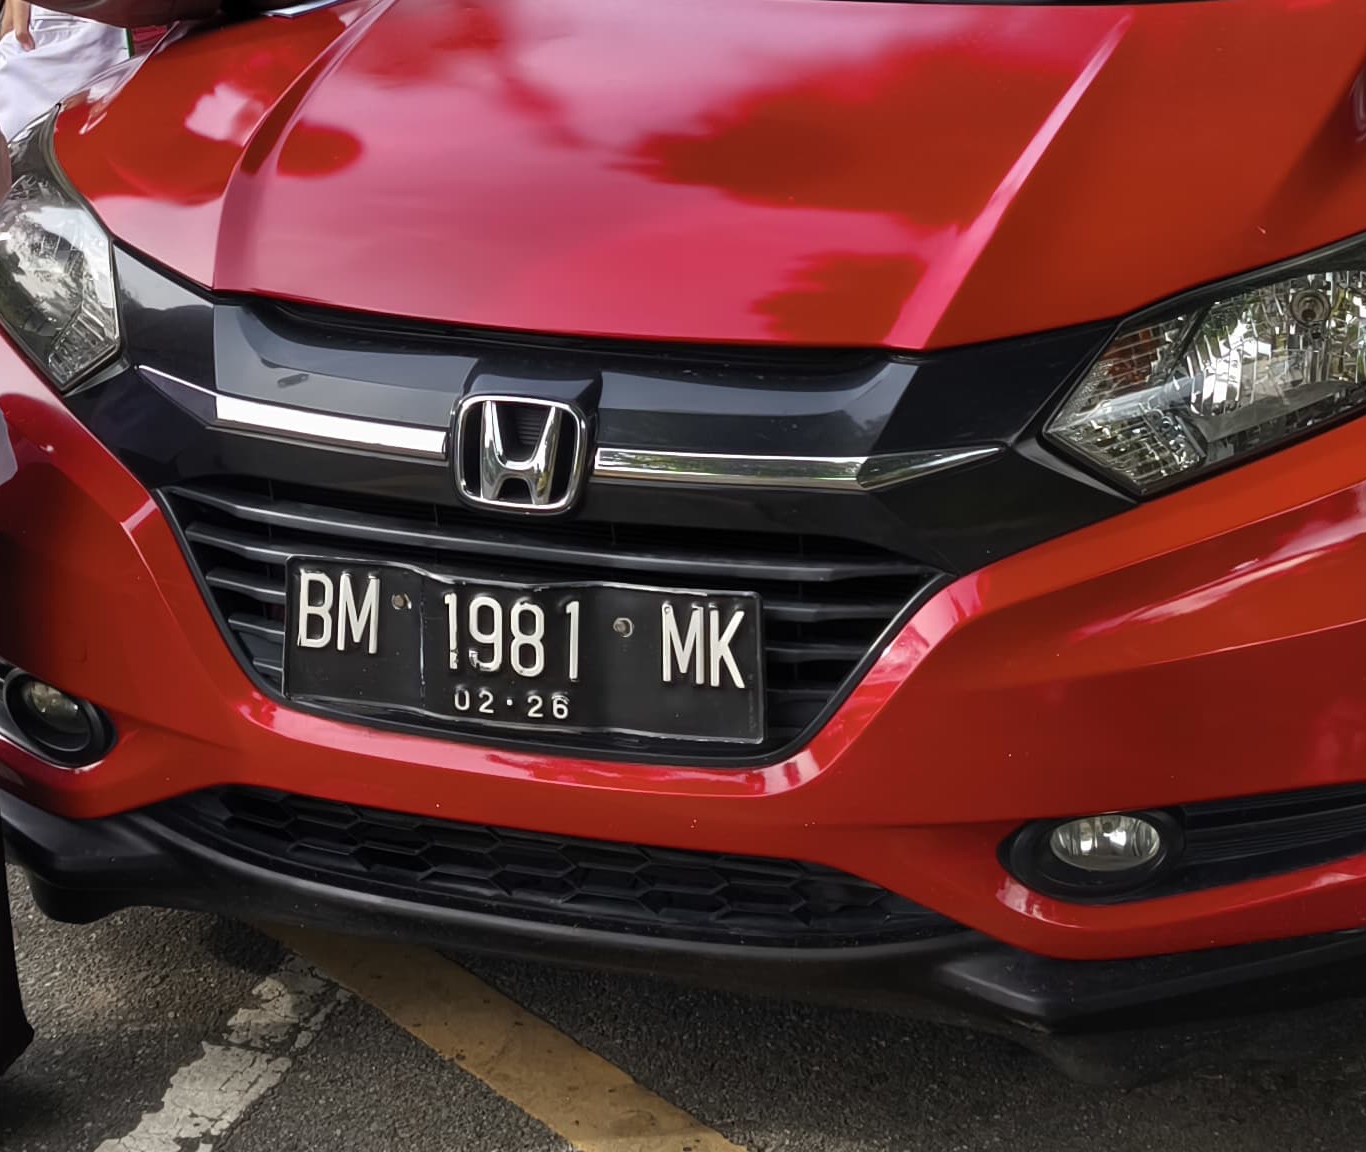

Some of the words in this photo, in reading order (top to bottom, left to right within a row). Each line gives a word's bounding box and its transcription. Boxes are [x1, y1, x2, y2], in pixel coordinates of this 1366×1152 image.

[297, 570, 381, 655] BM
[443, 592, 580, 682] 1981
[660, 601, 746, 689] MK
